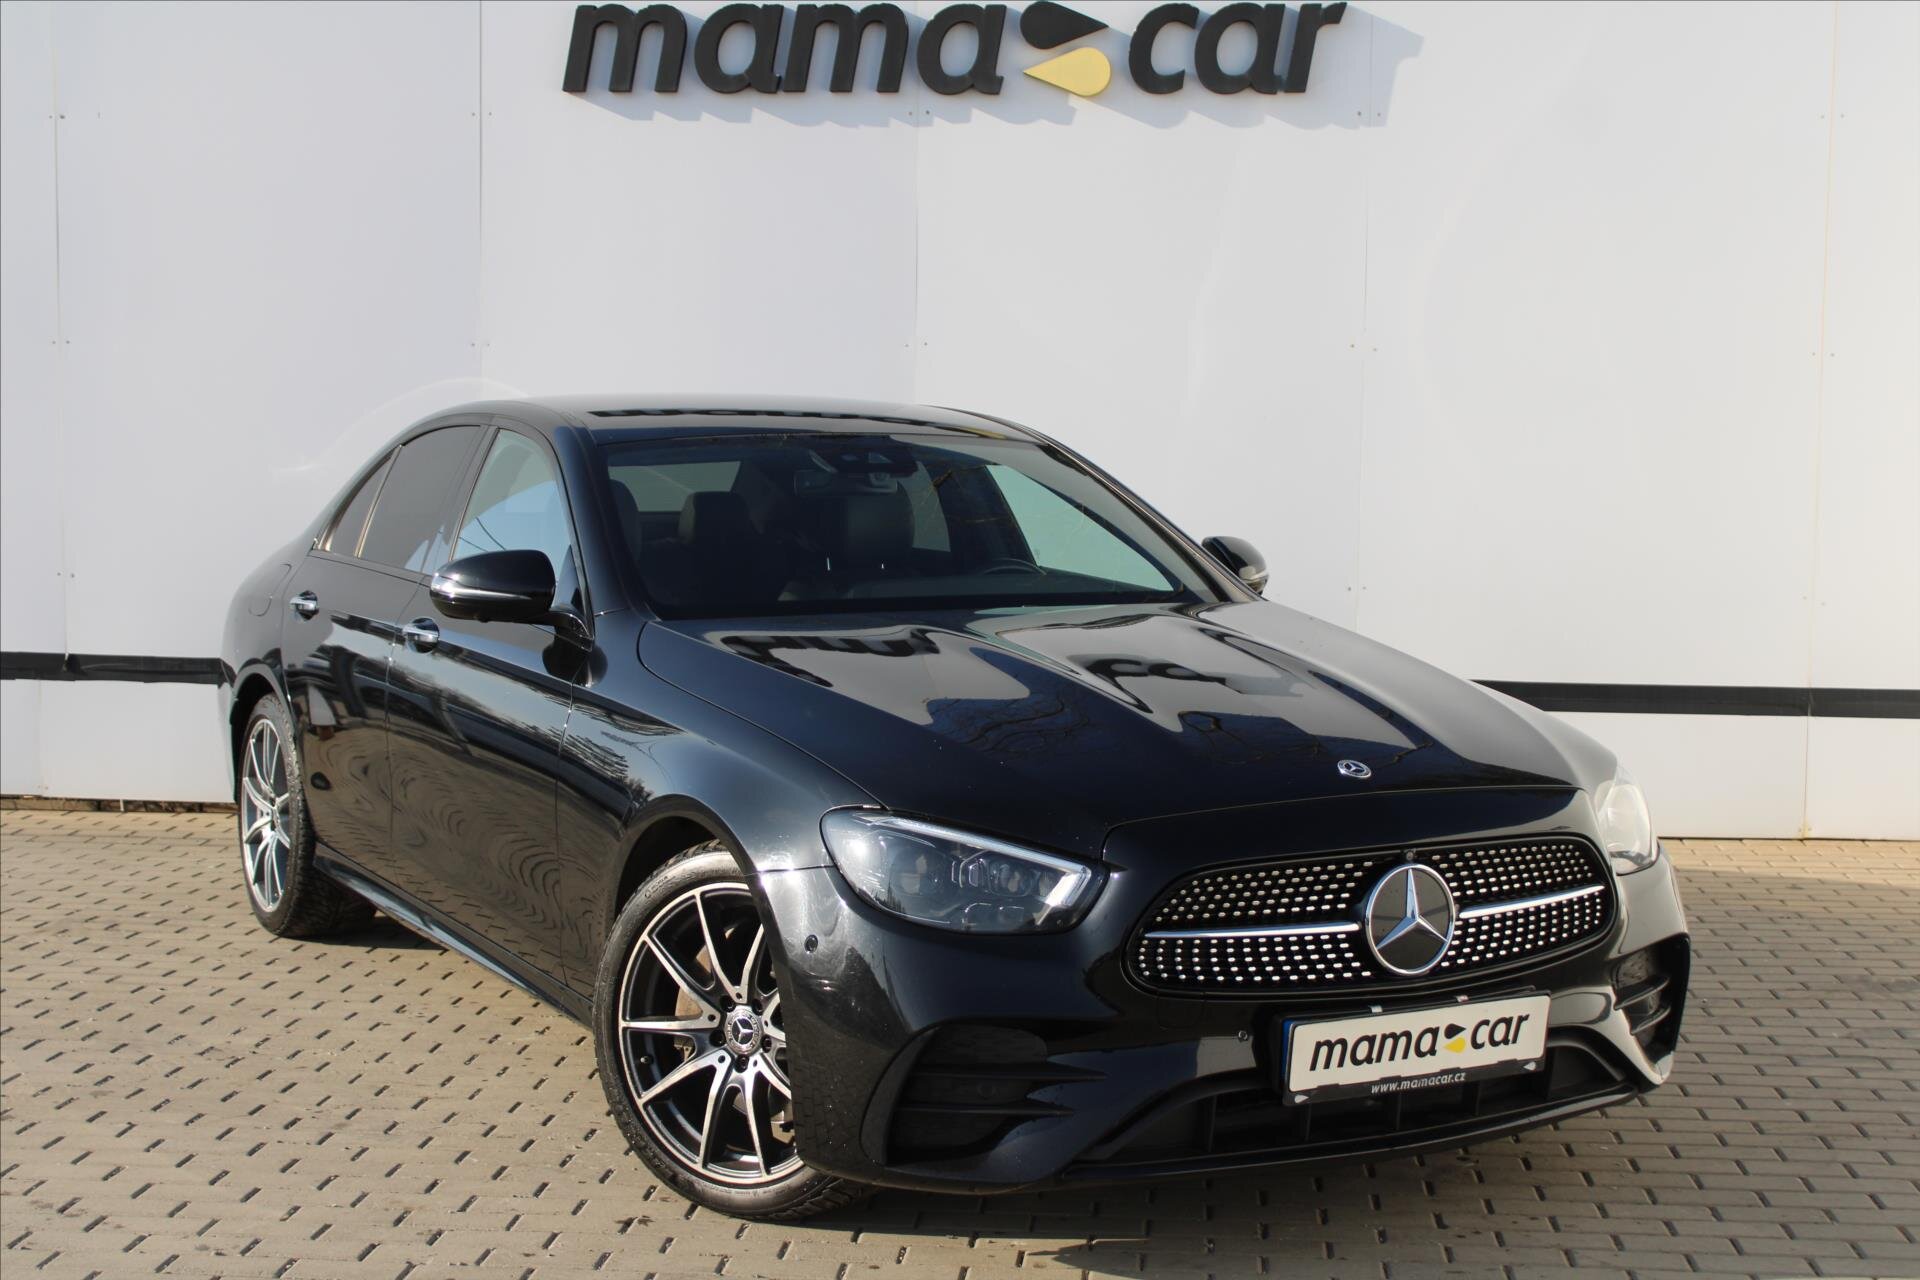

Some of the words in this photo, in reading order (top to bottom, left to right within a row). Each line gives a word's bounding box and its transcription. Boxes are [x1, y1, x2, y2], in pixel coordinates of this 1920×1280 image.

[562, 3, 1006, 94] mama
[1128, 1, 1347, 95] car
[1309, 1025, 1440, 1072] mama
[1470, 1013, 1530, 1050] car
[1371, 1072, 1467, 1094] www.mamacar.cz
